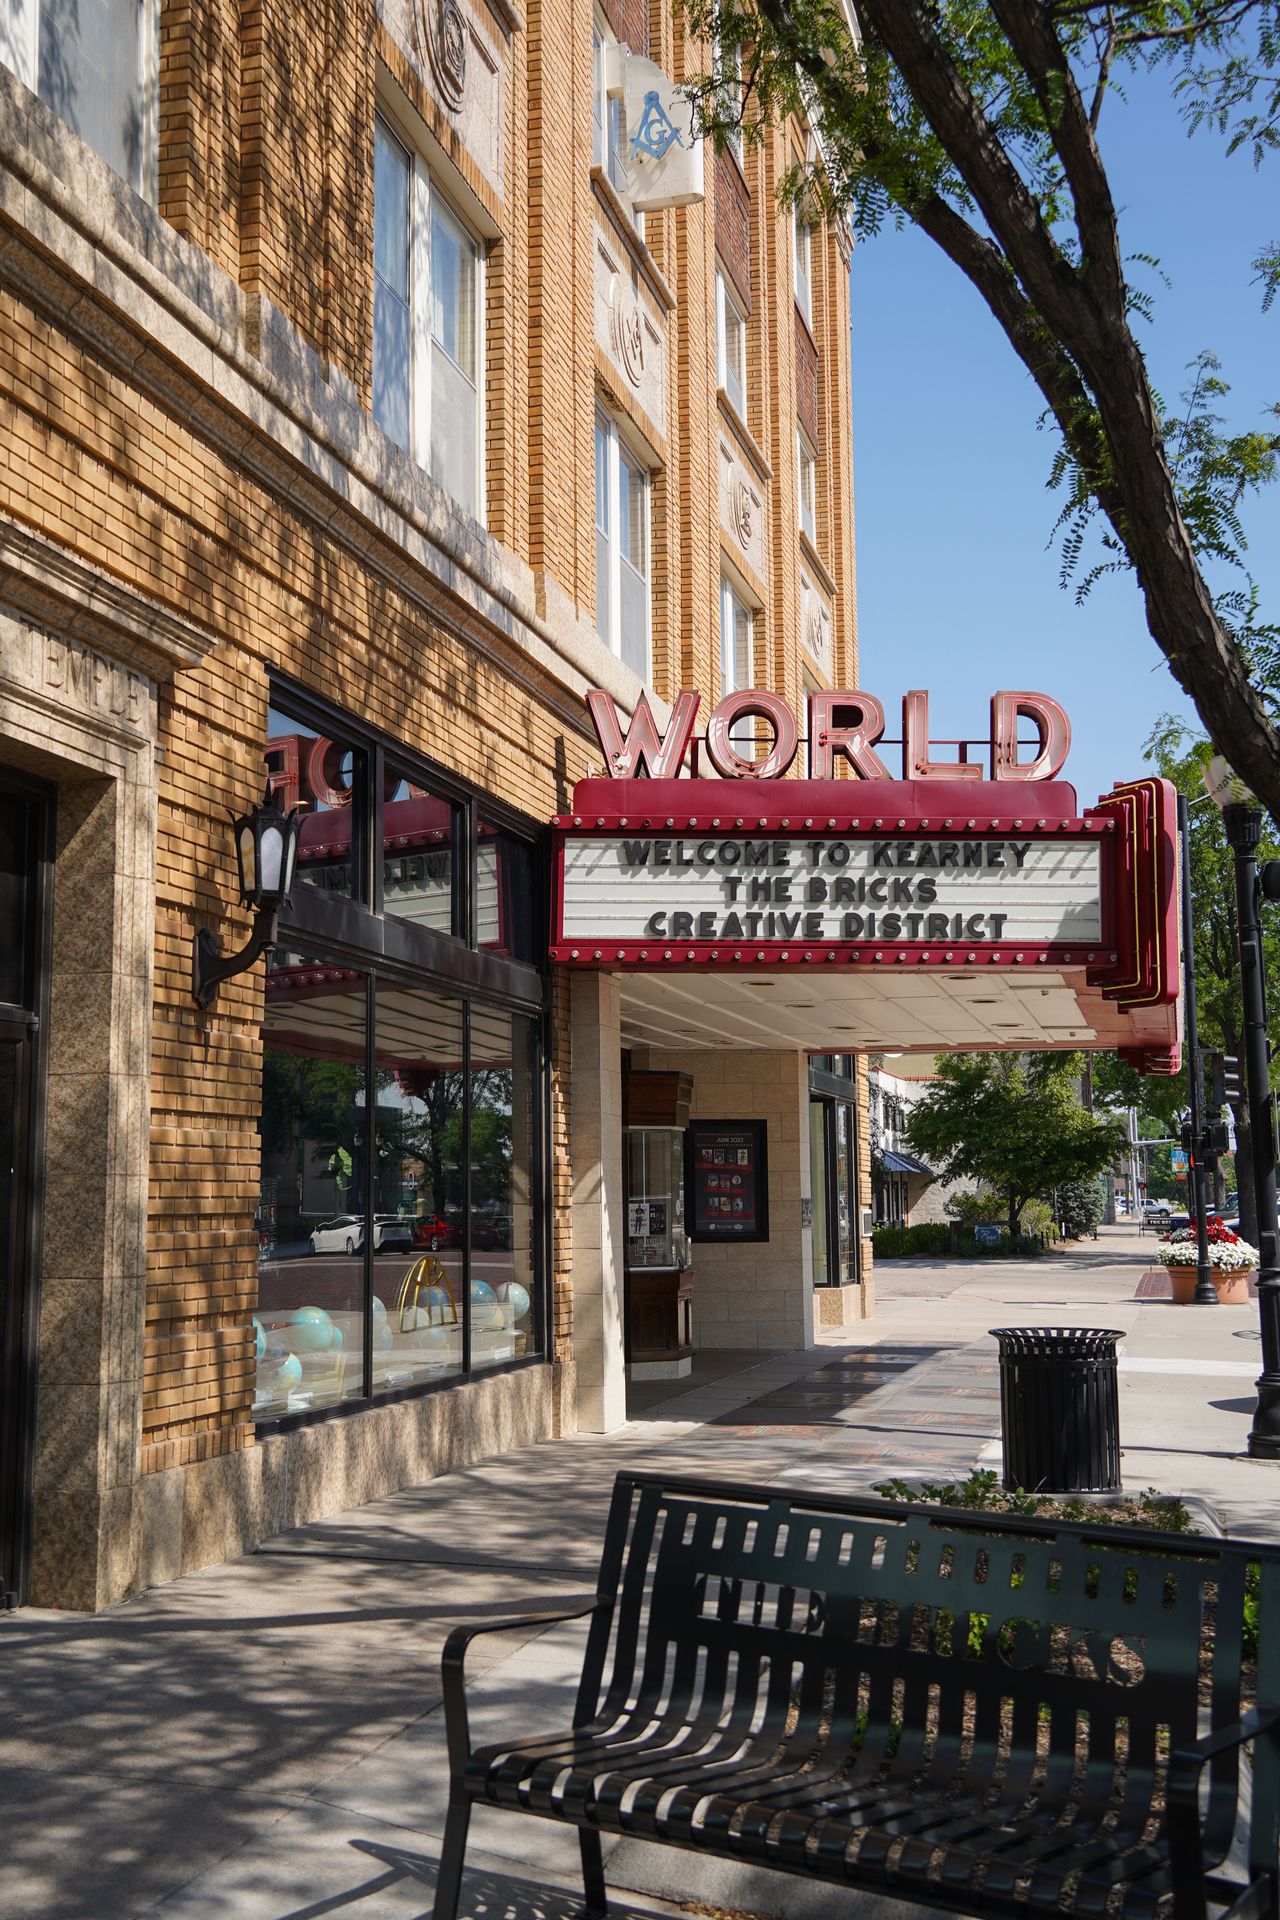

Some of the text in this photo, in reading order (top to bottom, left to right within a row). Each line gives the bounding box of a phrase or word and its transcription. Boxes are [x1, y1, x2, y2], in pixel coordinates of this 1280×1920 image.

[643, 118, 667, 146] G
[19, 614, 143, 724] TEMPLE
[586, 688, 1073, 782] WORLD
[622, 839, 1033, 868] WELCOME TO KEARNEY
[725, 876, 938, 903] THE BRICKS
[648, 911, 1008, 939] CREATIVE DISTRICT
[694, 1572, 1148, 1689] THE BRICKS
